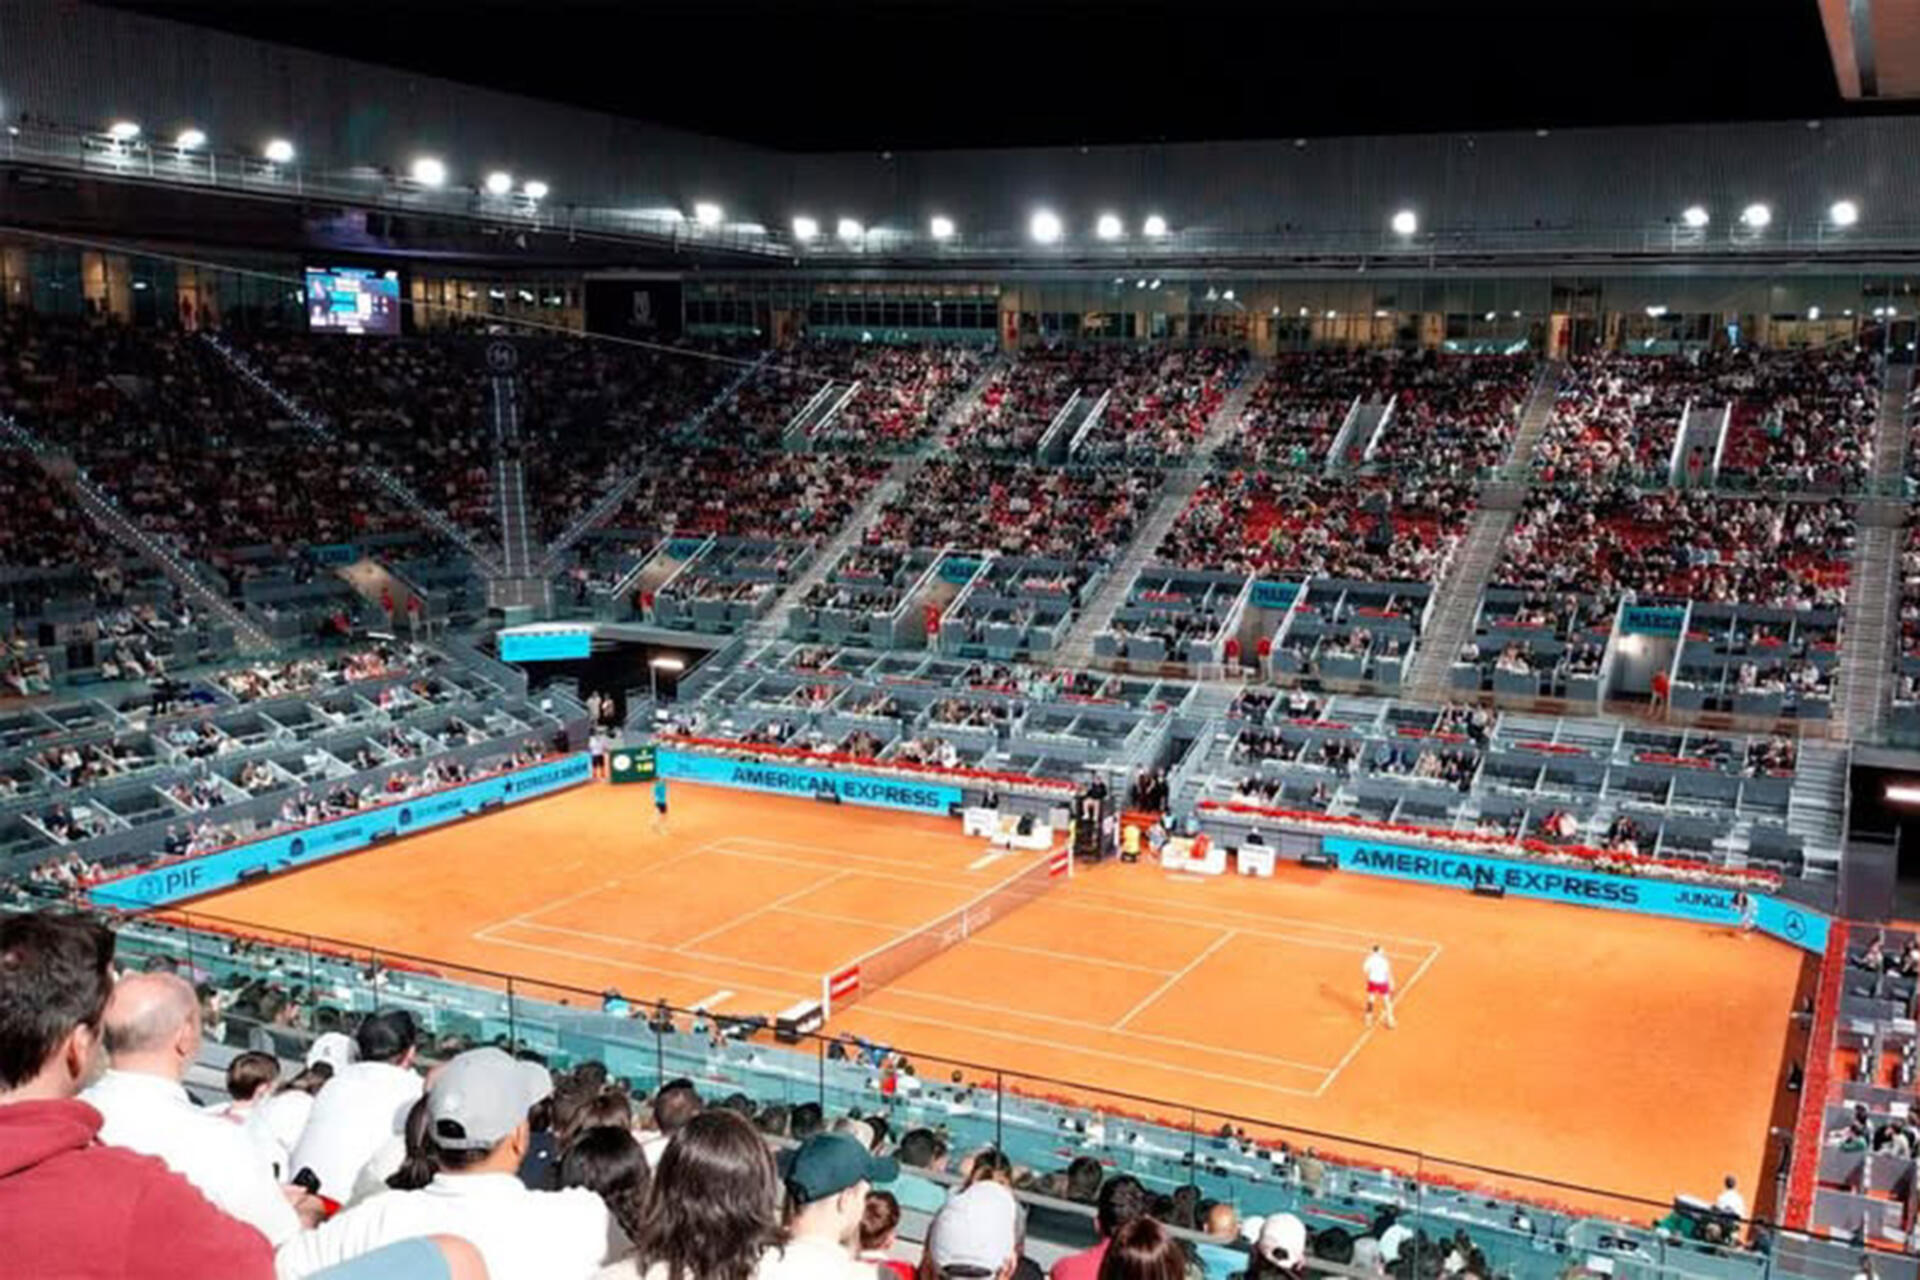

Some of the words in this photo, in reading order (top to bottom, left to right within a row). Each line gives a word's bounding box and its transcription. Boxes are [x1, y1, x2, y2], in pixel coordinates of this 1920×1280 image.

[731, 767, 836, 793] AMERICAN
[843, 780, 940, 808] EXPRESS
[166, 865, 204, 895] PIF
[1351, 847, 1496, 885] AMERICAN
[1505, 868, 1640, 904] EXPRESS
[1675, 890, 1732, 909] JUNGL
